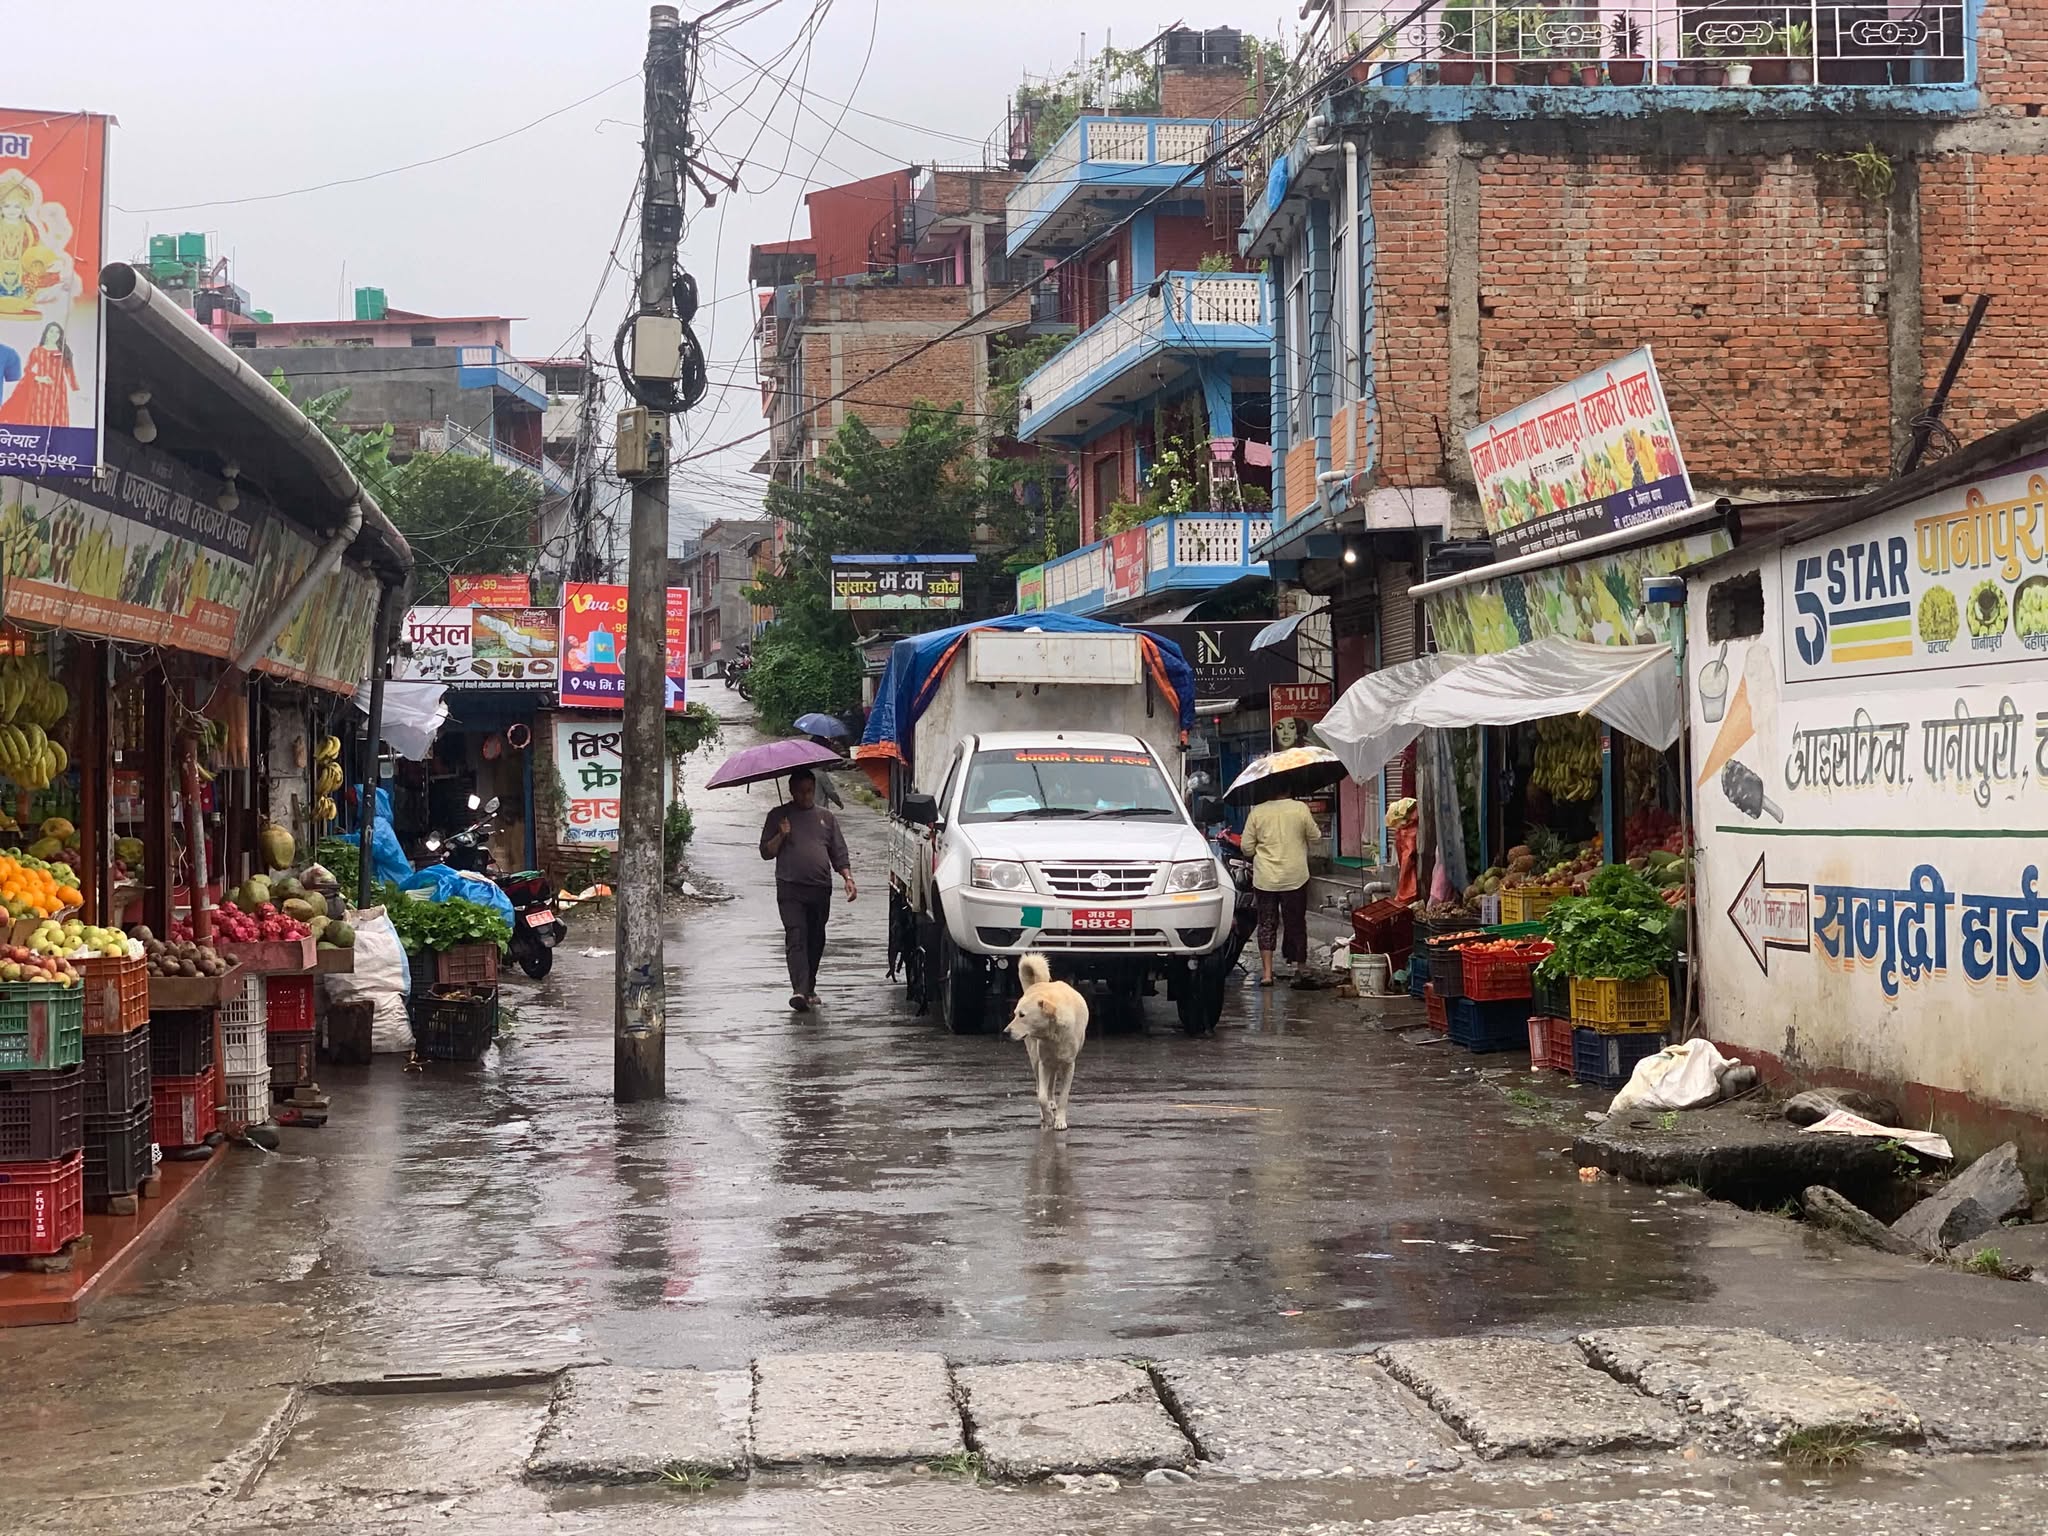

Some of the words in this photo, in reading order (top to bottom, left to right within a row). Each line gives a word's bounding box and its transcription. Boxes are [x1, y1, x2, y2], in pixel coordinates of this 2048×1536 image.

[1489, 424, 1524, 470] किराना
[1520, 418, 1542, 460] तथा
[1580, 372, 1624, 437] तरकारी
[1620, 371, 1656, 420] पसल
[169, 492, 193, 524] तथा
[1827, 535, 1911, 606] STAR
[927, 578, 960, 594] उद्योग
[410, 624, 471, 647] पसल
[1971, 634, 2003, 652] पानीपुरी
[1211, 666, 1246, 676] LOOK
[1273, 701, 1298, 712] Beauty
[1074, 918, 1131, 928] १४८२
[1962, 865, 2048, 981] हार्ड
[35, 1190, 45, 1231] FRUITS
